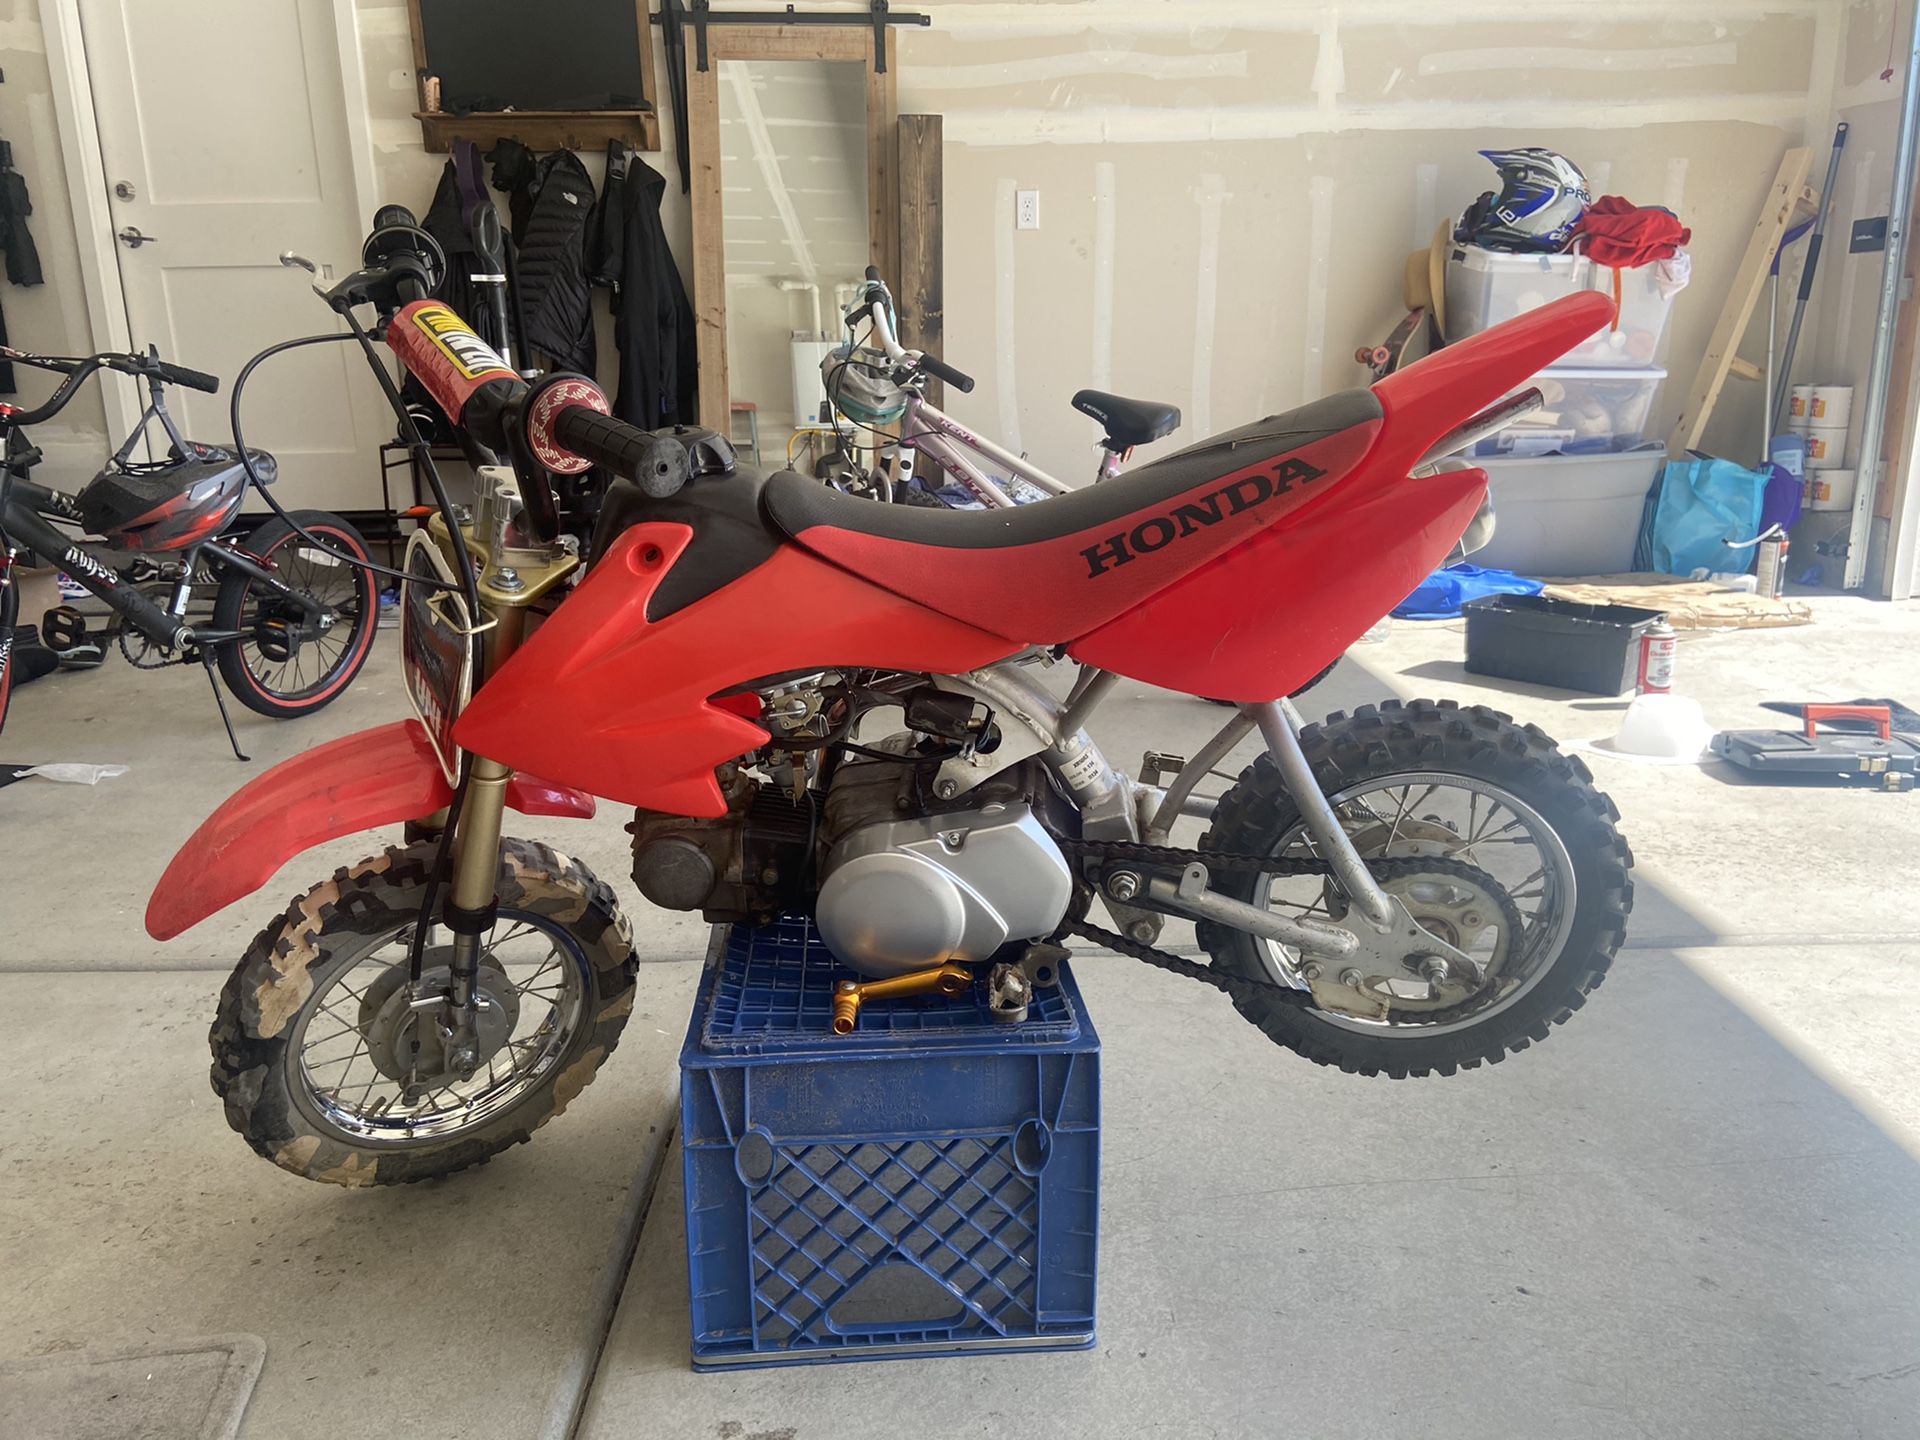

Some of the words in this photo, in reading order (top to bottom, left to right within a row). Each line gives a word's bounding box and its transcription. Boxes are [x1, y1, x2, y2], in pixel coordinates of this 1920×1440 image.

[1563, 186, 1592, 203] PRO
[940, 418, 976, 443] KENT
[1079, 457, 1328, 579] HONDA
